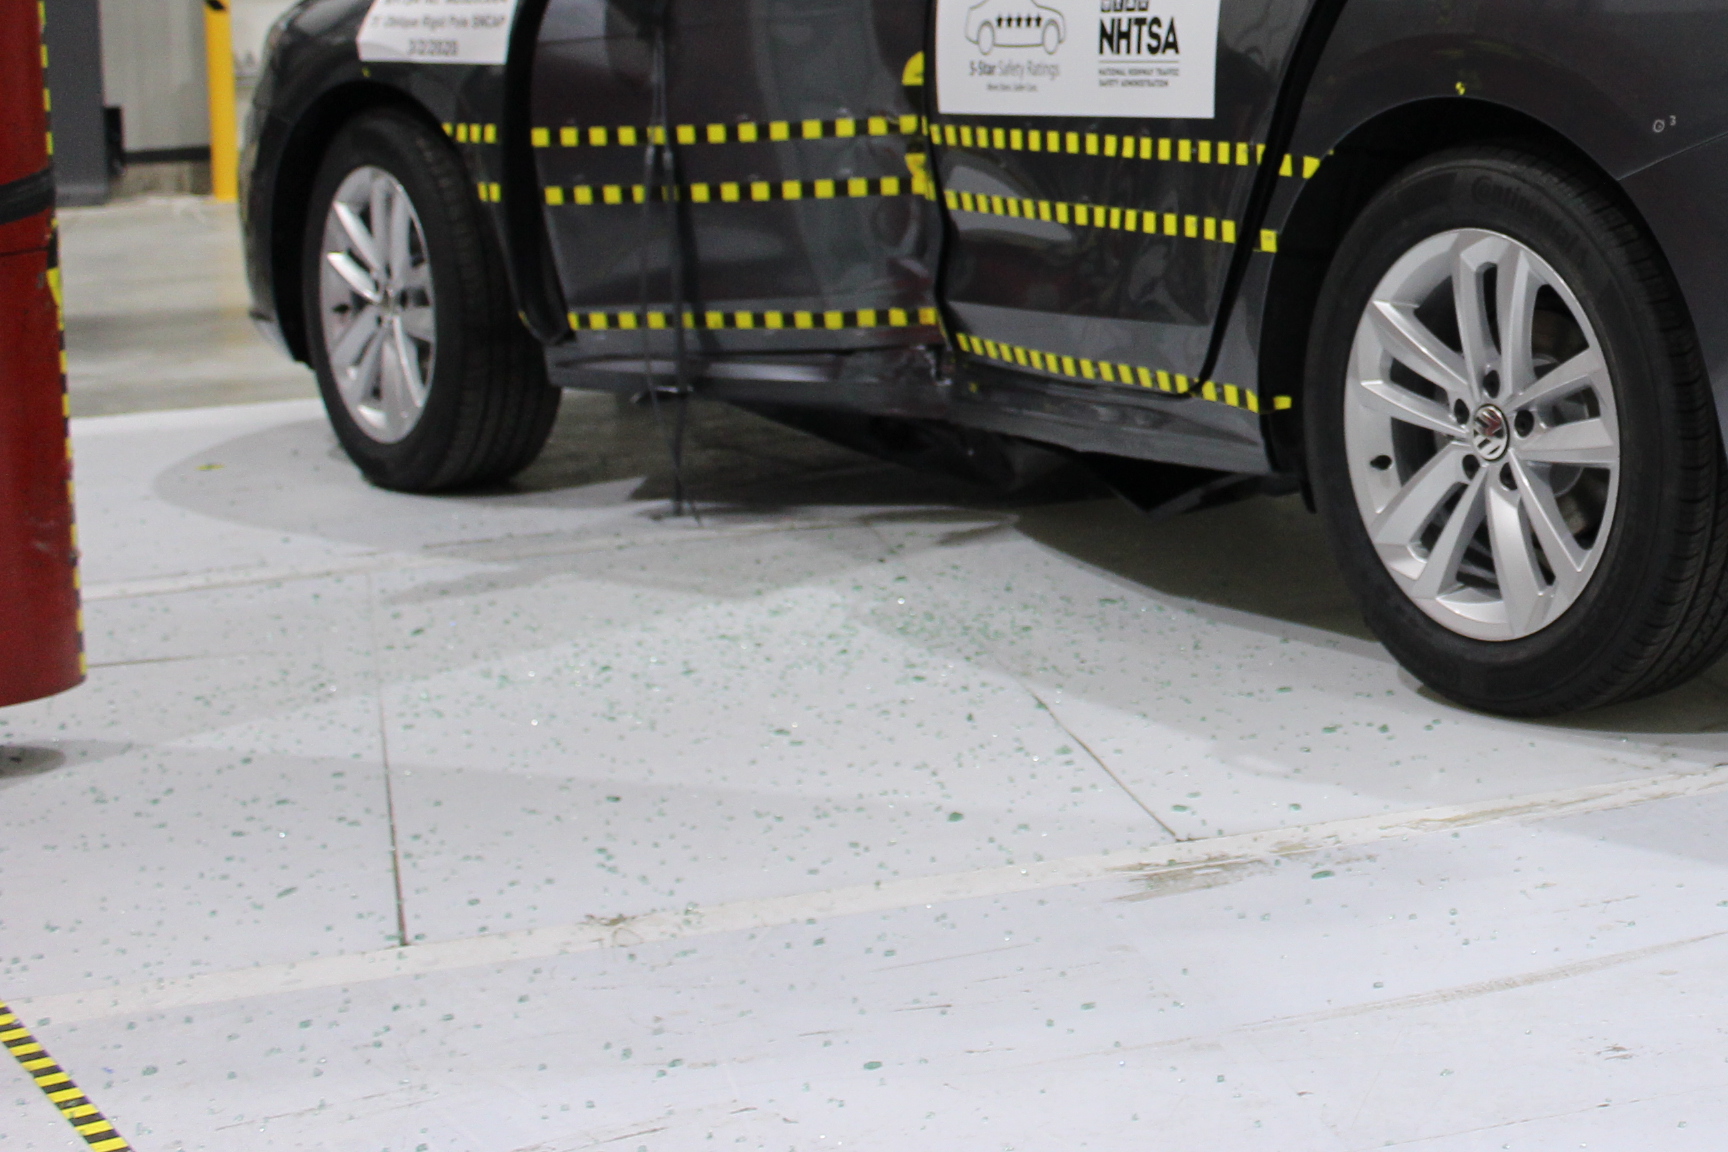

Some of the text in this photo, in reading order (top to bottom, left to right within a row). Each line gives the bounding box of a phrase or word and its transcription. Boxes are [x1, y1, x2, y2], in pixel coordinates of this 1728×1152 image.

[1098, 17, 1180, 55] NHTSA
[969, 60, 1060, 80] 5-Star Safety Ratings
